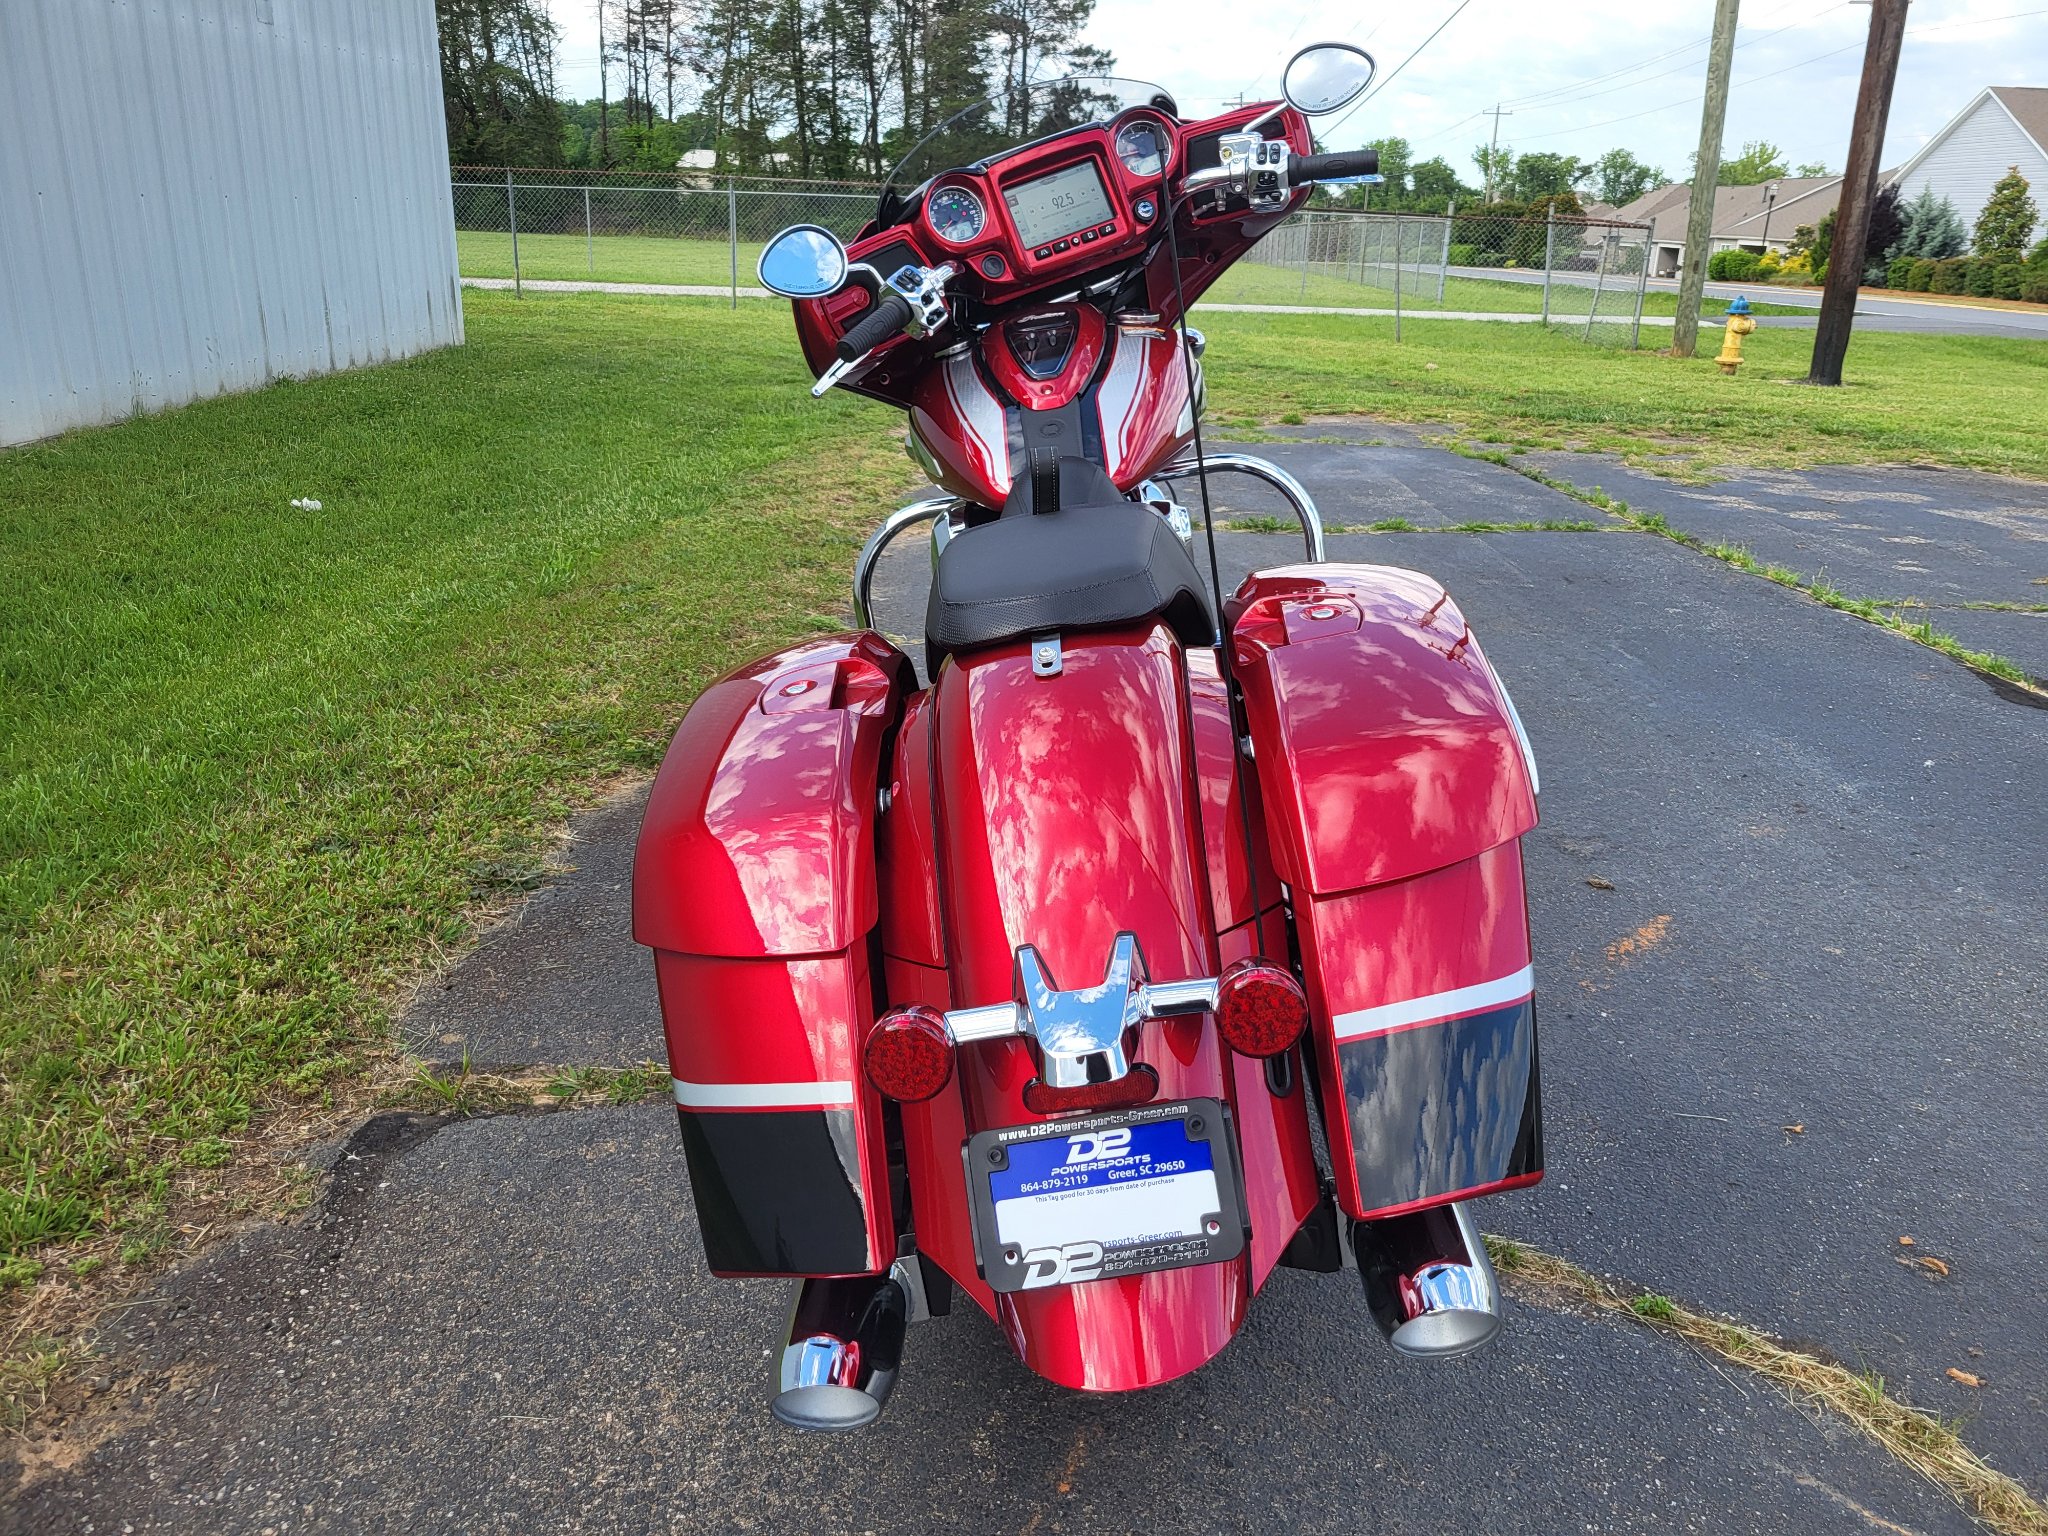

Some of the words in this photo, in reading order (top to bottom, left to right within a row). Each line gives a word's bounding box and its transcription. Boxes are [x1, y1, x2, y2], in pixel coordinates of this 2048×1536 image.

[998, 1105, 1189, 1142] www.D2Powersports-Greer.com
[1066, 1128, 1132, 1165] D2
[1051, 1154, 1151, 1176] POWERSPORTS
[1108, 1166, 1138, 1180] Greer,
[1139, 1164, 1153, 1176] SC
[1154, 1160, 1185, 1174] 29650
[1020, 1174, 1088, 1193] 864-879-2119
[1035, 1195, 1047, 1203] This
[1048, 1194, 1059, 1202] Tag
[1060, 1191, 1076, 1201] good
[1076, 1190, 1085, 1198] for
[1086, 1188, 1094, 1196] 30
[1095, 1187, 1109, 1196] days
[1110, 1184, 1125, 1193] from
[1126, 1182, 1139, 1190] date
[1140, 1180, 1147, 1188] of
[1147, 1177, 1175, 1188] purchase
[1102, 1230, 1183, 1248] rsports-Greer.com
[1022, 1240, 1103, 1289] D2
